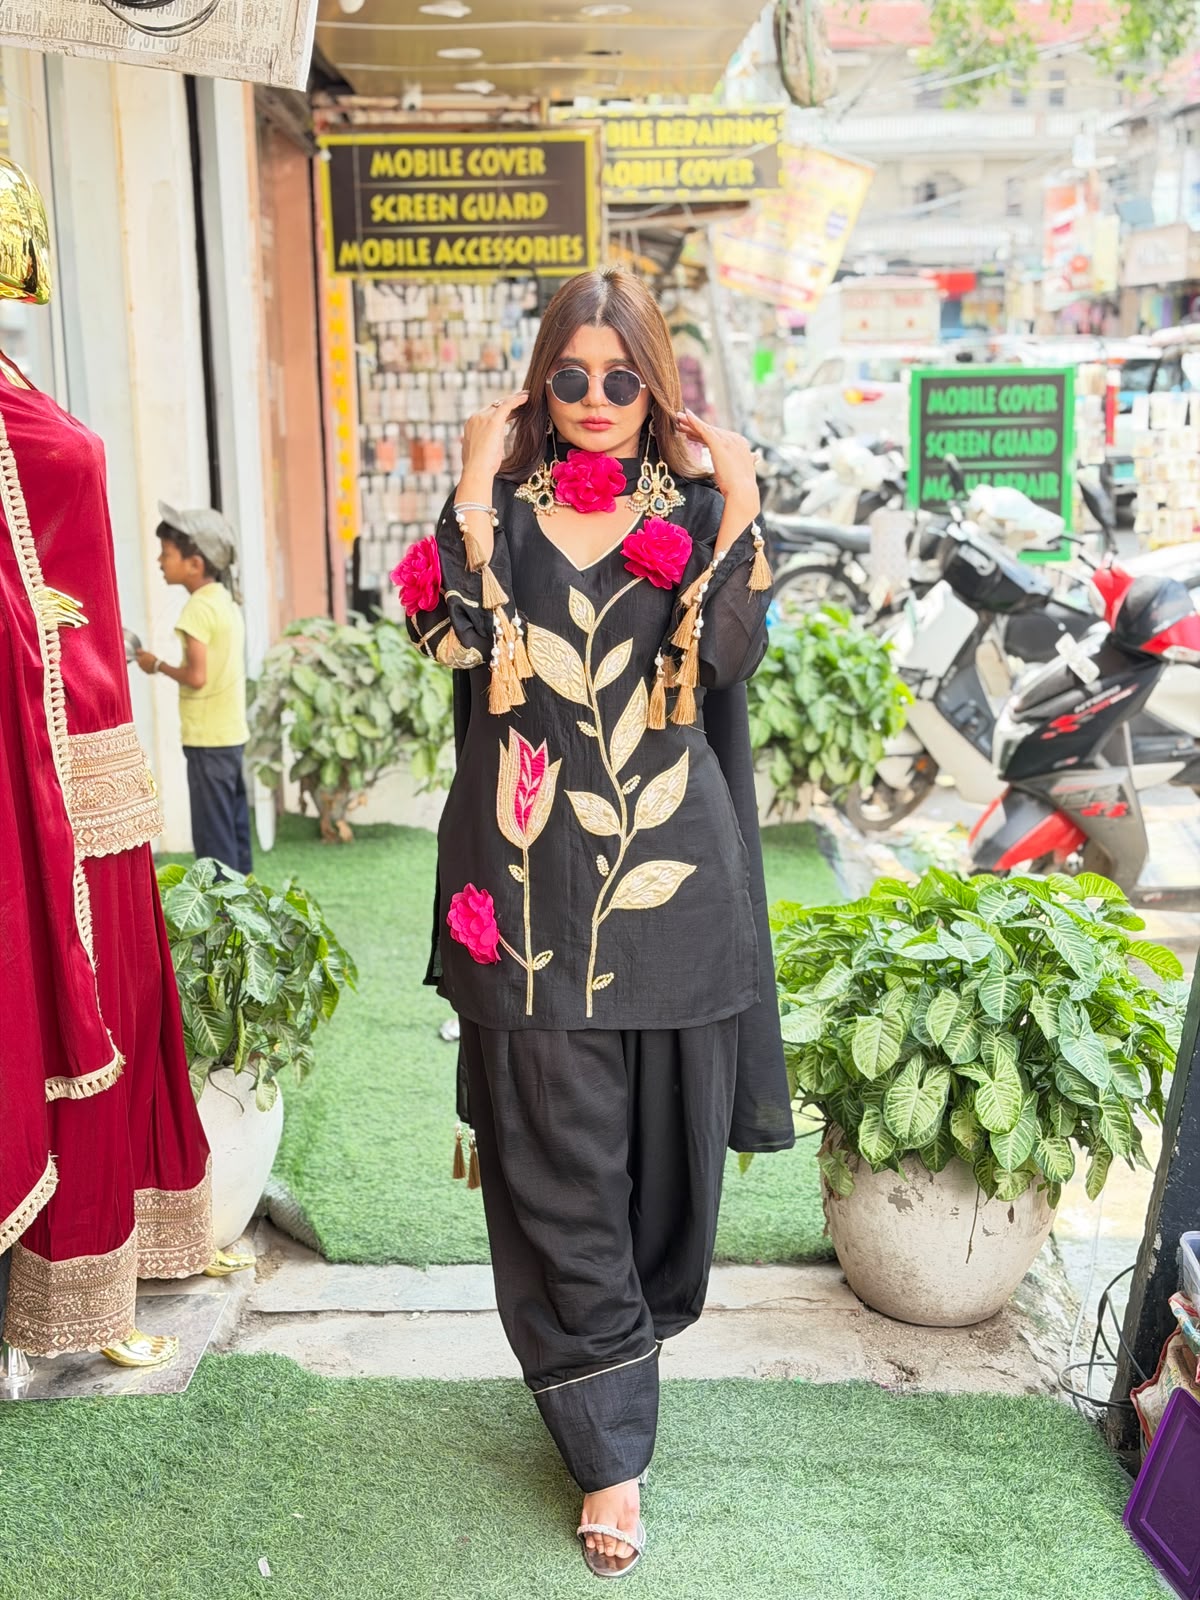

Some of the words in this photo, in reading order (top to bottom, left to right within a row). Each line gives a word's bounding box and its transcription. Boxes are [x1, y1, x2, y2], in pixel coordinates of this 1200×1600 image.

[656, 117, 778, 146] REPAIRING
[370, 150, 464, 178] MOBILE
[467, 147, 546, 176] COVER
[679, 159, 756, 187] COVER
[370, 193, 458, 222] SCREEN
[461, 192, 548, 220] GUARD
[339, 238, 431, 267] MOBILE
[434, 234, 584, 264] ACCESSORIES
[926, 386, 998, 415] MOBILE
[1000, 384, 1059, 414] COVER
[925, 430, 990, 459] SCREEN
[992, 428, 1058, 457] GUARD
